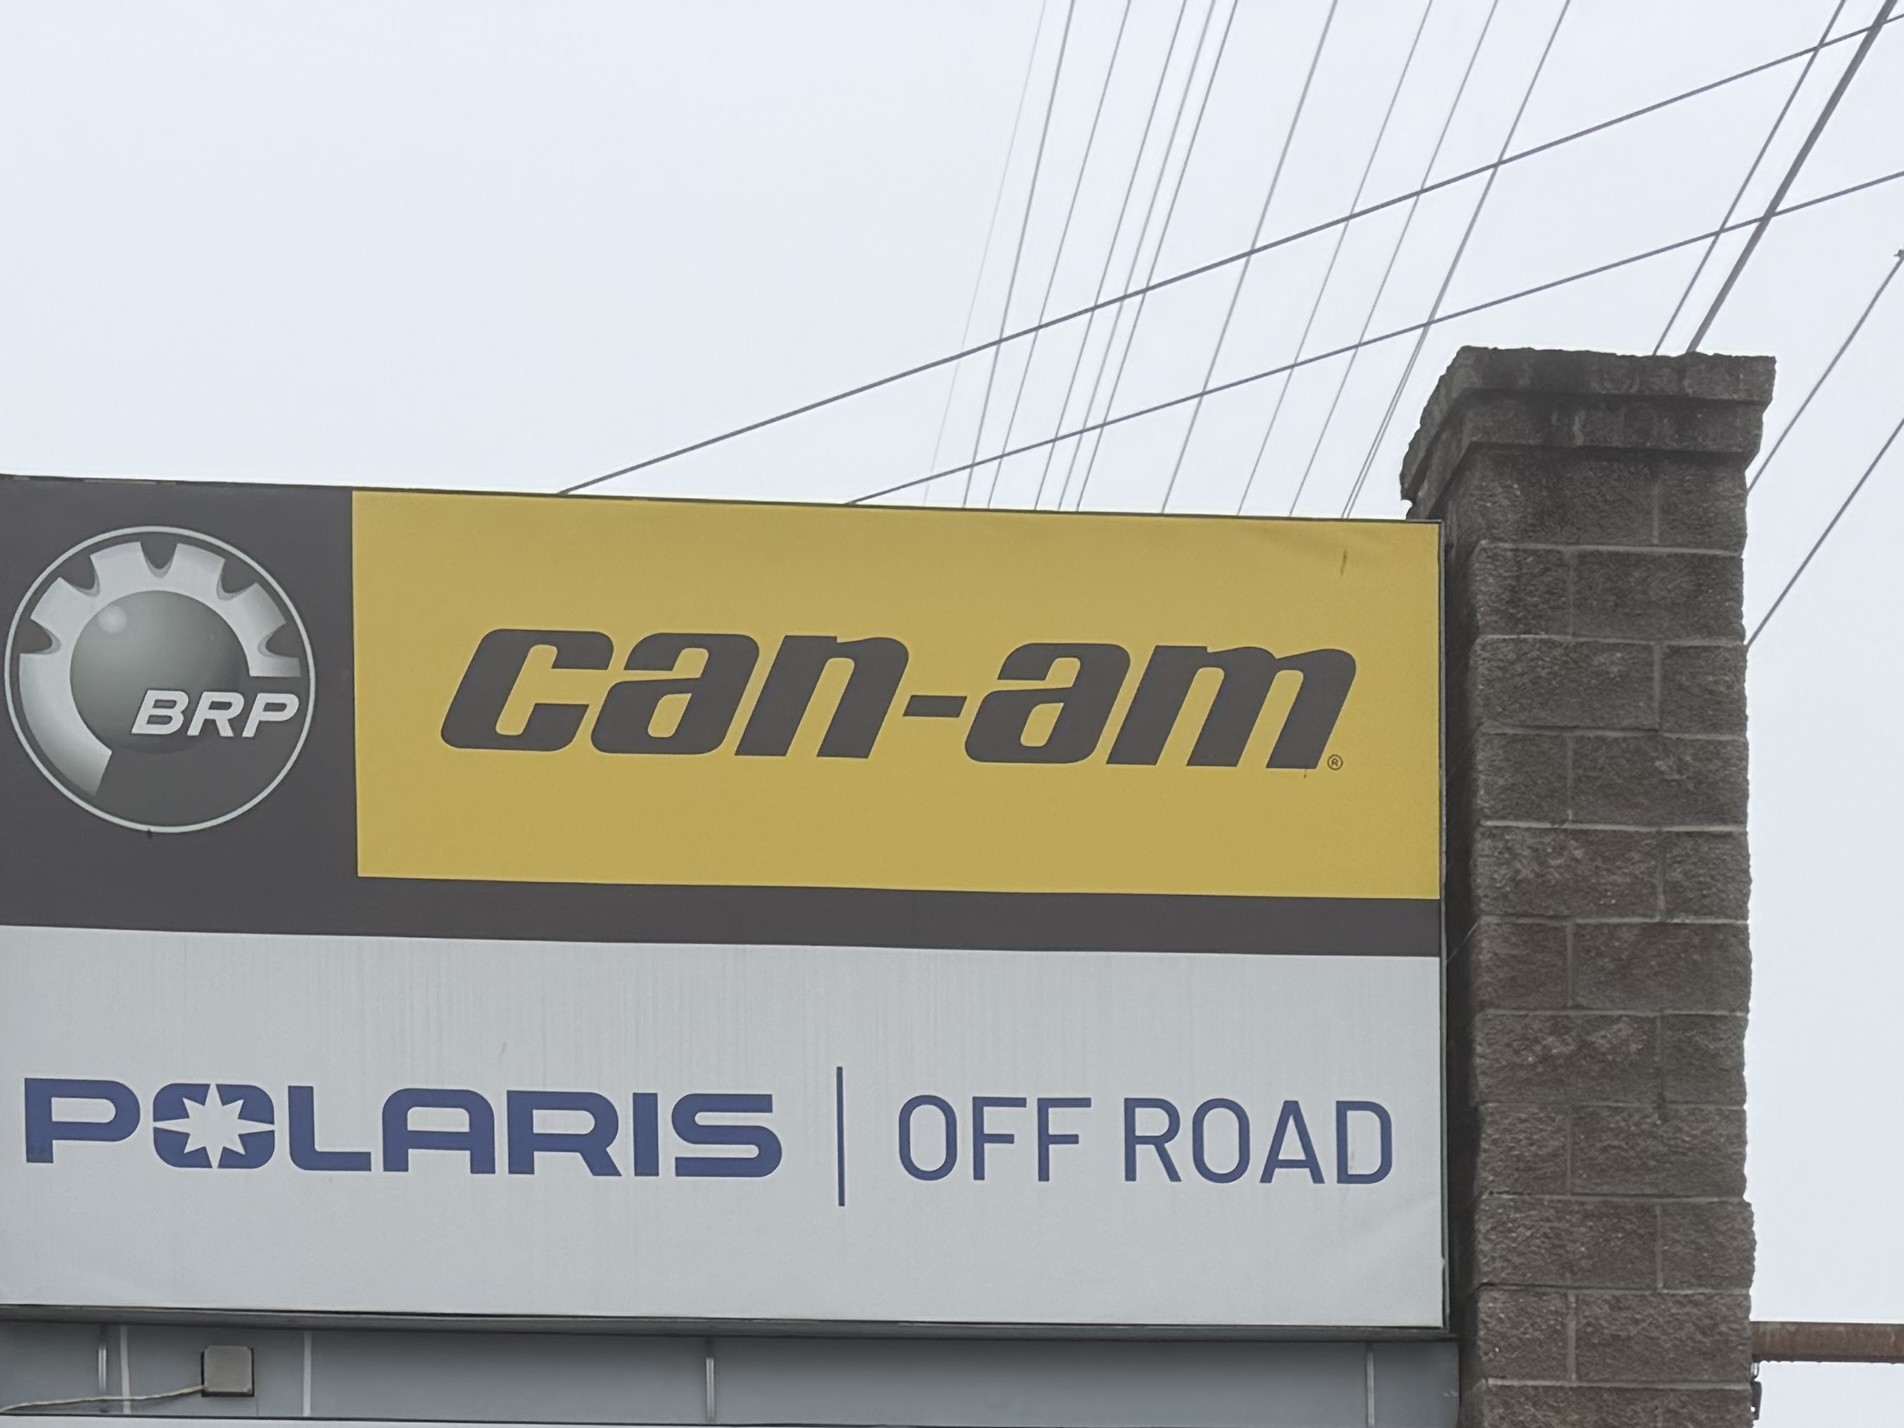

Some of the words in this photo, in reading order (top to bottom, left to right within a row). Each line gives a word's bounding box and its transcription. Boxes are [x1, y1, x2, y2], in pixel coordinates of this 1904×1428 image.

[131, 687, 300, 739] BRP
[440, 627, 1358, 771] can-am
[23, 1076, 784, 1180] POLARIS
[898, 1094, 1093, 1184] OFF
[1124, 1097, 1394, 1186] ROAD
